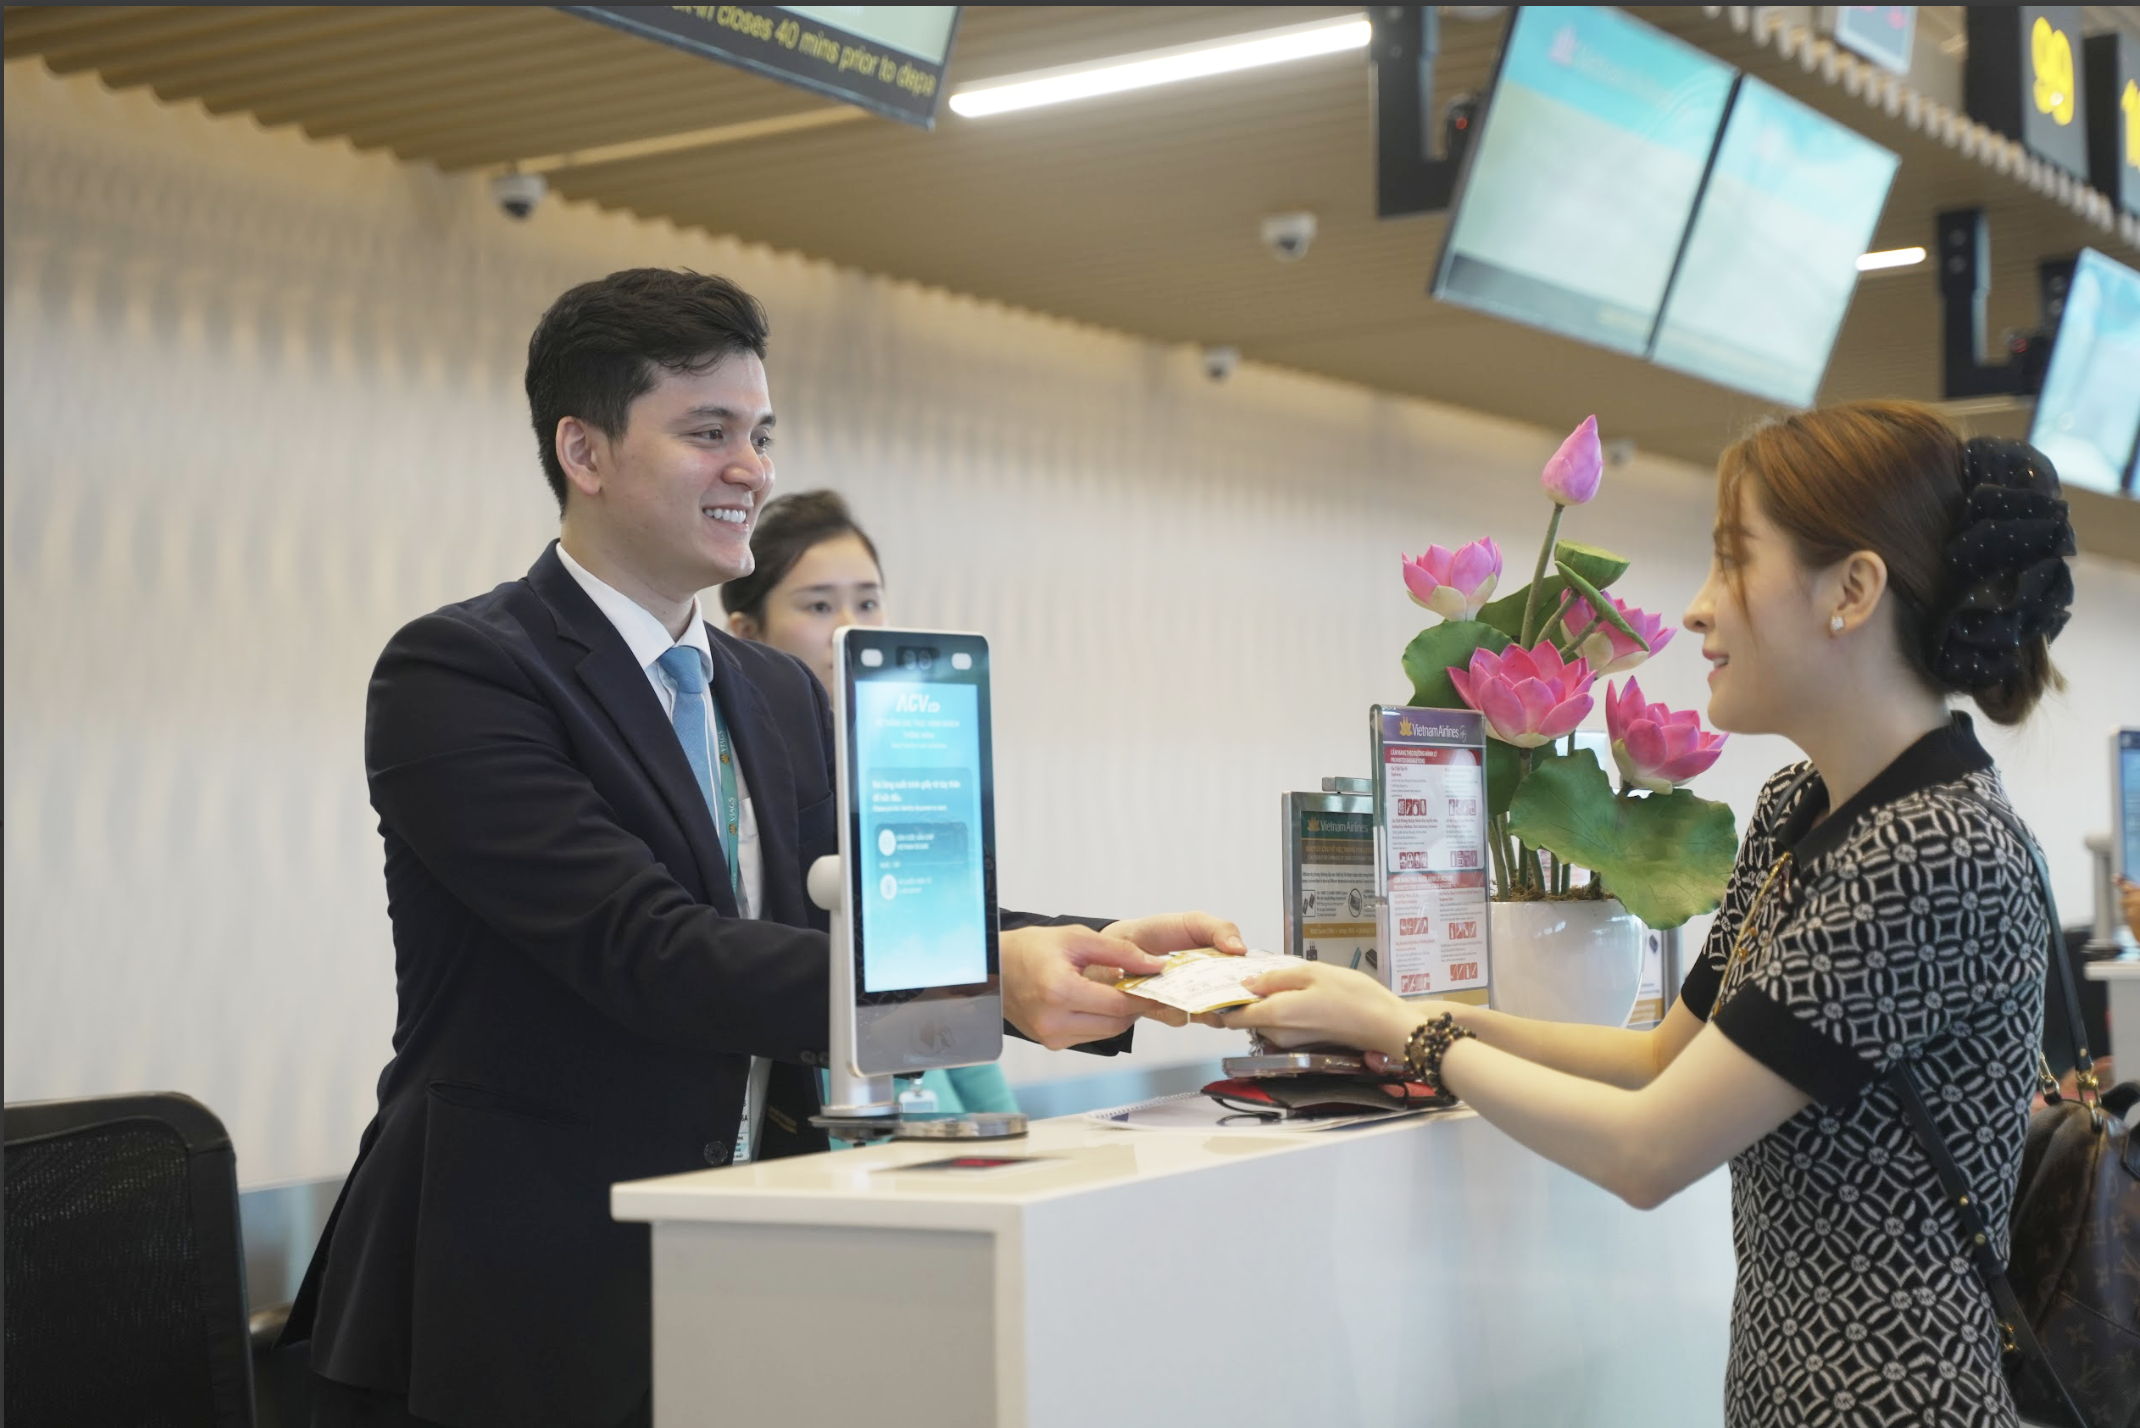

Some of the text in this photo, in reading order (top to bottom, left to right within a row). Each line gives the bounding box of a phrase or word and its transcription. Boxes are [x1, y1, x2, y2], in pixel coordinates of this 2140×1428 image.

[717, 6, 774, 42] closes
[774, 18, 800, 50] 40
[798, 30, 841, 64] mins
[838, 45, 880, 73] prior
[877, 53, 897, 83] to
[2031, 16, 2075, 126] 99
[1320, 820, 1369, 833] Vietnam Airlines
